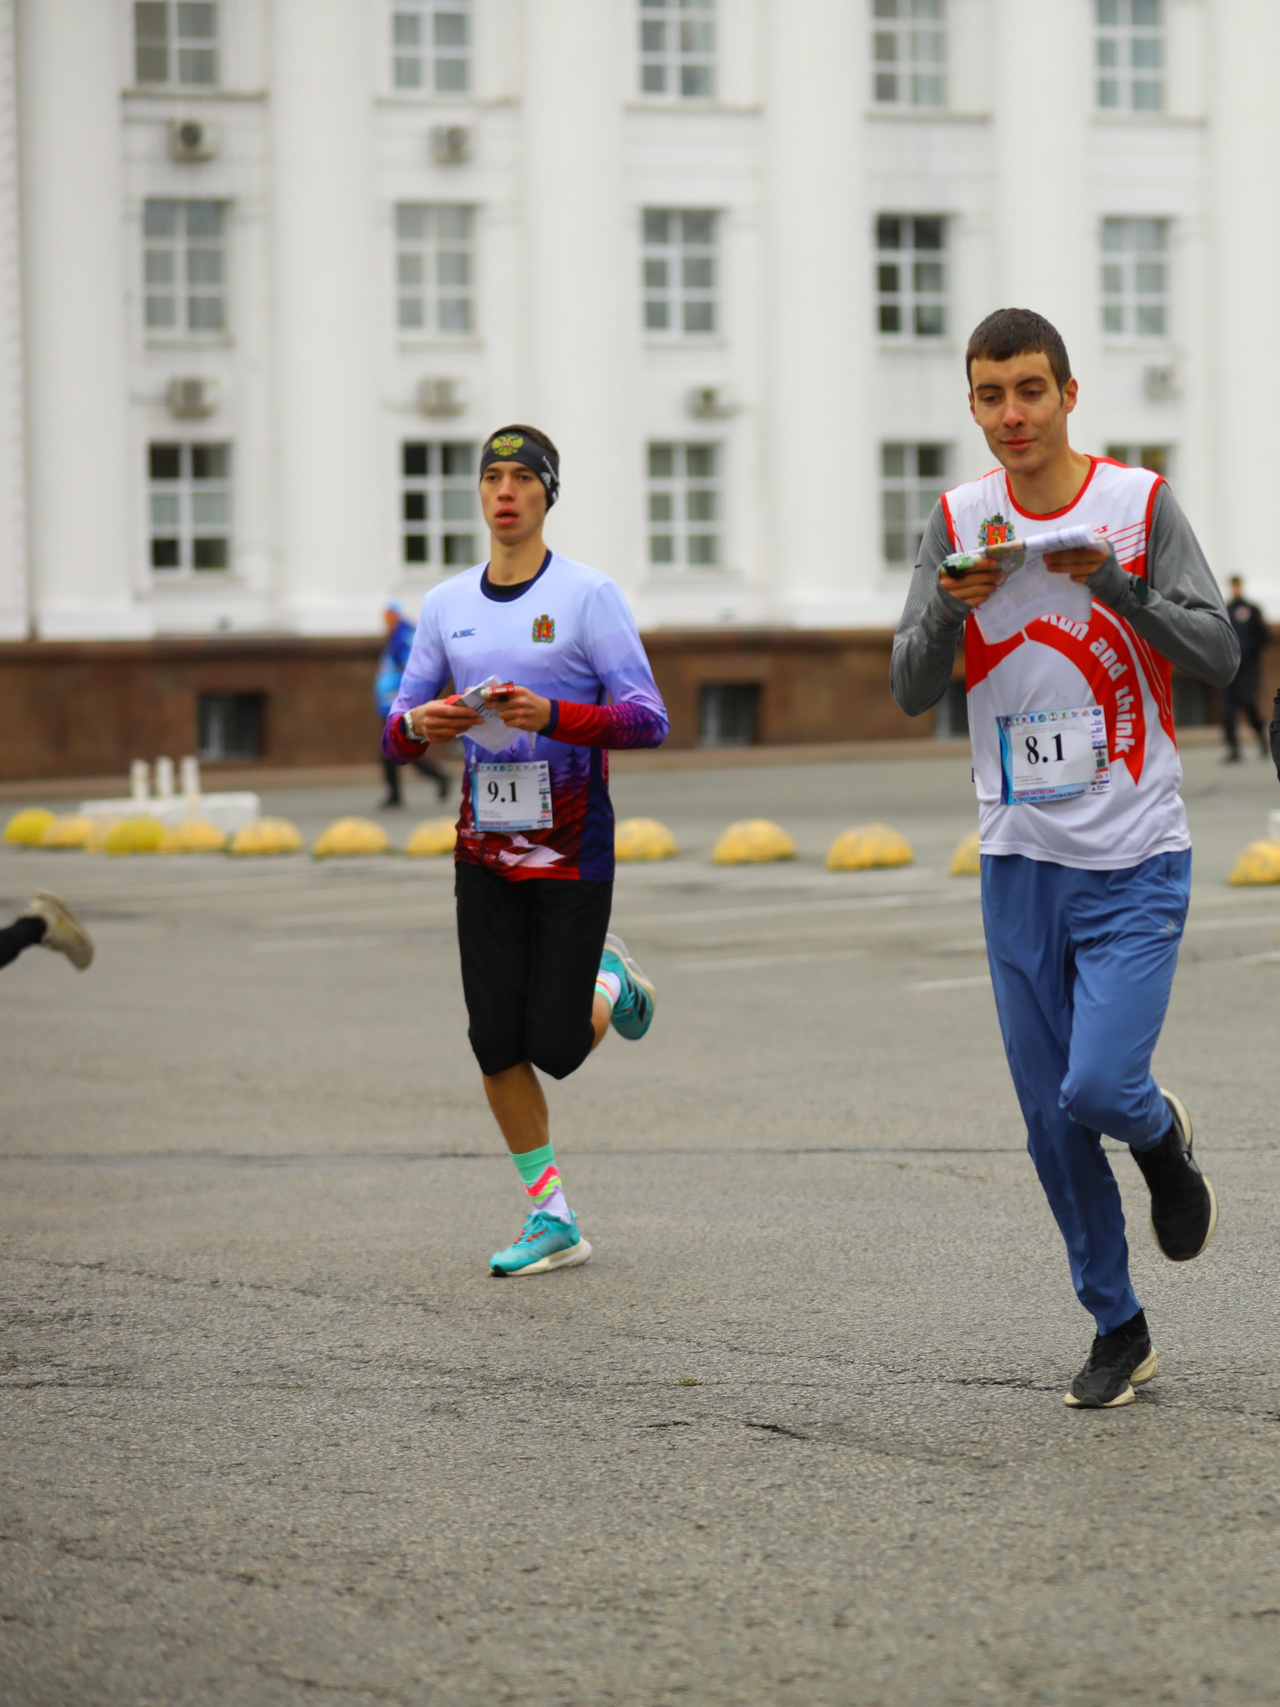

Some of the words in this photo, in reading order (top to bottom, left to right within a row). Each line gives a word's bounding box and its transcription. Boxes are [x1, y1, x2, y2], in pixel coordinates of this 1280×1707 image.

[1089, 636, 1129, 682] and
[1114, 685, 1136, 754] think
[1025, 732, 1066, 765] 8.1
[487, 780, 519, 803] 9.1
